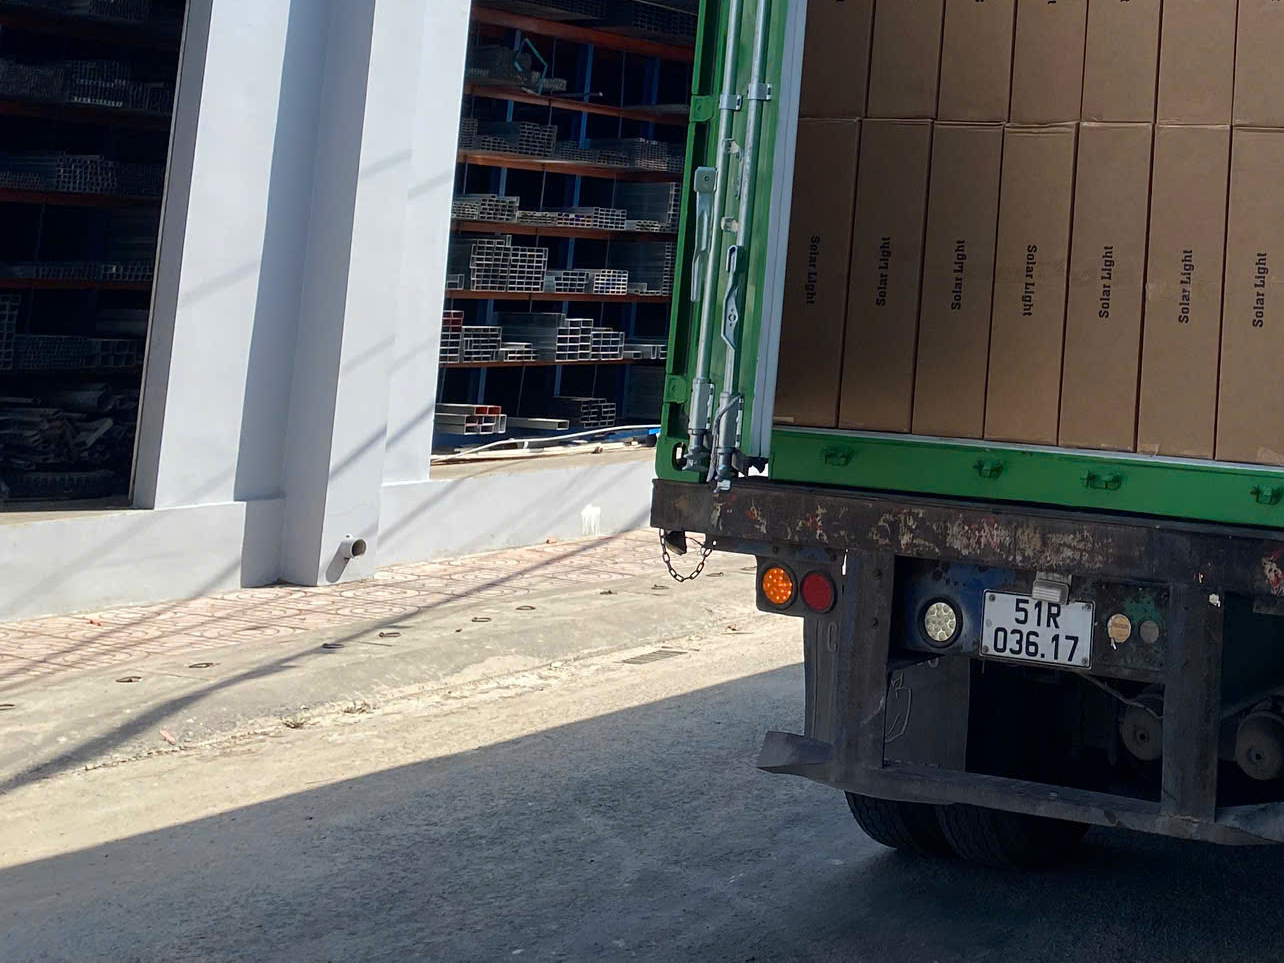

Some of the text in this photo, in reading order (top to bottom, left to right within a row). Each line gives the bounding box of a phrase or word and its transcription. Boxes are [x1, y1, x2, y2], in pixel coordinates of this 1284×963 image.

[804, 235, 821, 305] Solar Light
[875, 236, 892, 307] Solar Light
[950, 239, 967, 311] Solar Light
[1021, 244, 1038, 317] Solar Light
[1098, 245, 1115, 319] Solar Light
[1177, 249, 1195, 324] Solar Light
[1251, 252, 1269, 328] Solar Light
[993, 627, 1079, 662] 036.17
[1014, 598, 1061, 629] 51R
